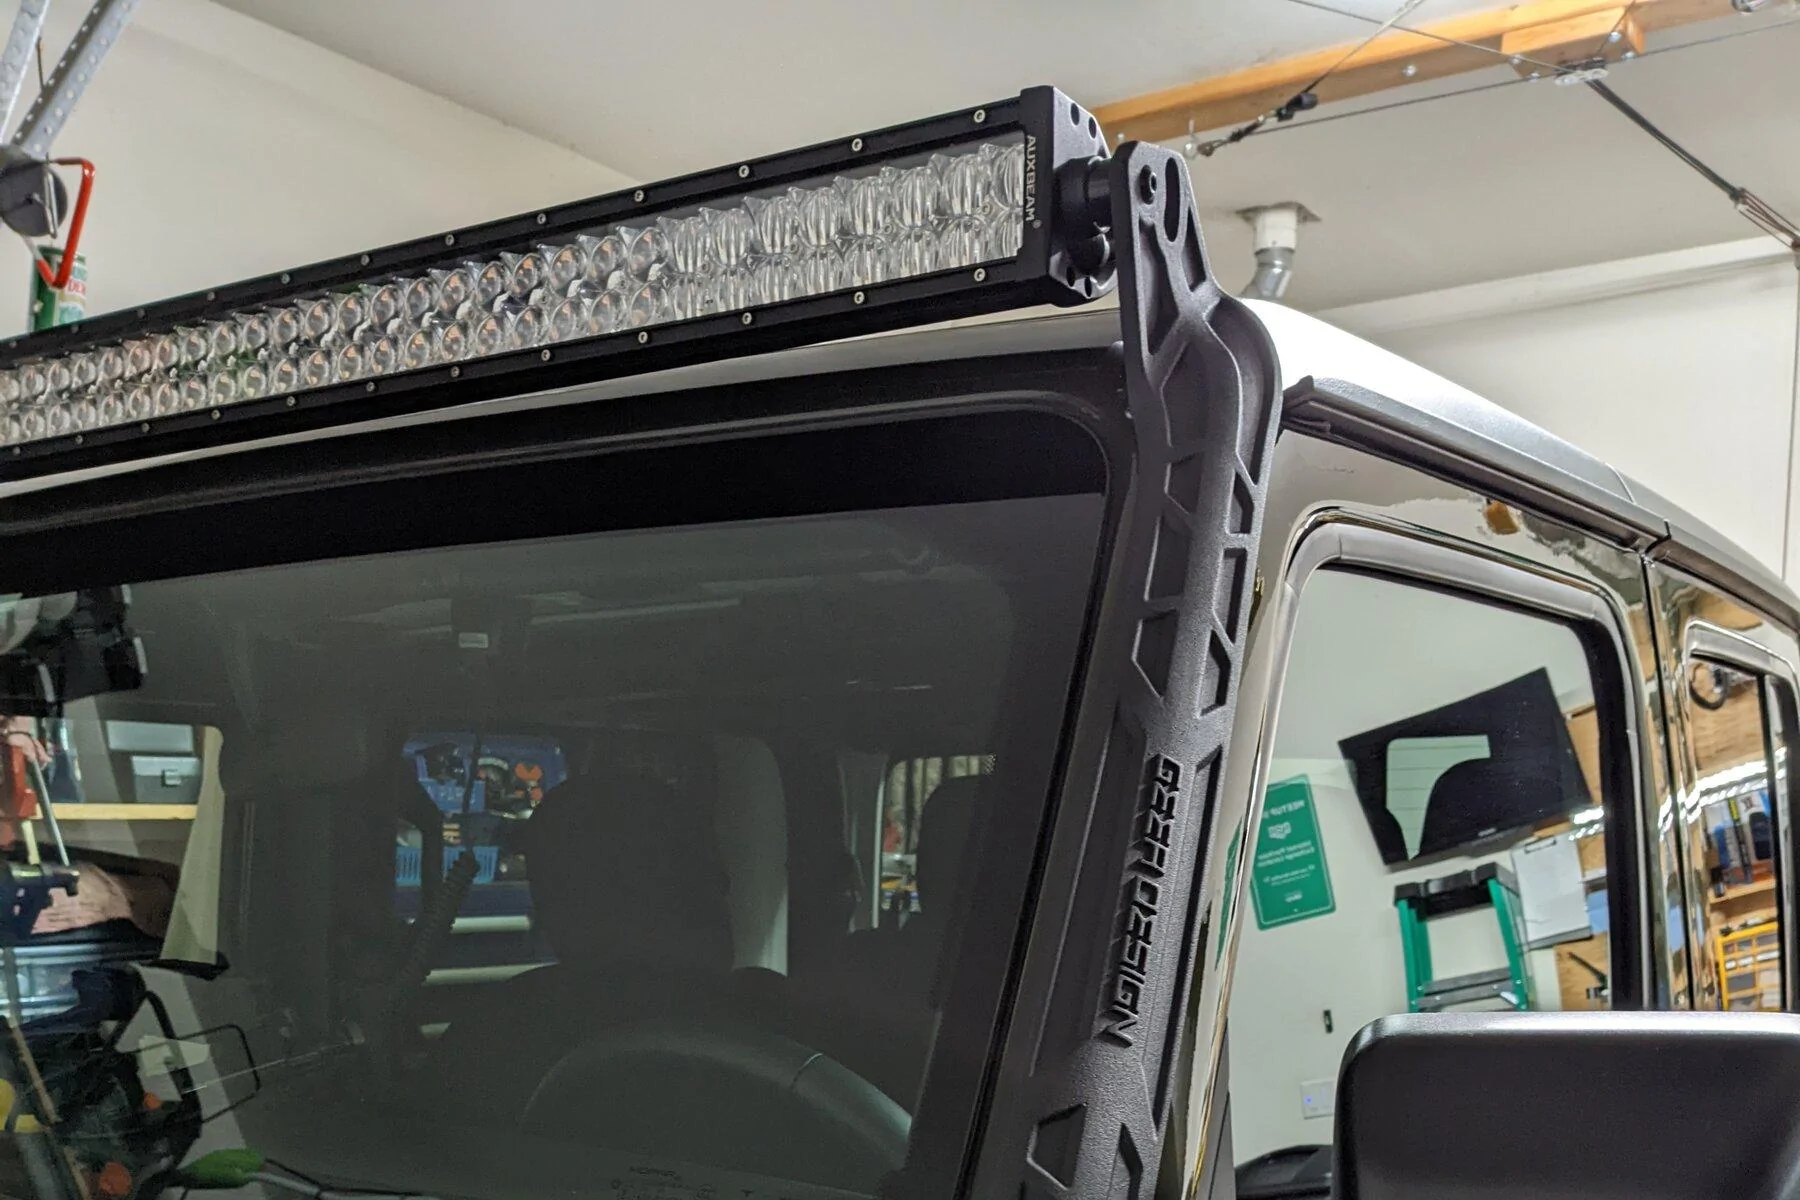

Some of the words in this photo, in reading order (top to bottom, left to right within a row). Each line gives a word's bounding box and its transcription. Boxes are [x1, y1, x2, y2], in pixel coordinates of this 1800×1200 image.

[1026, 135, 1037, 222] AUXBEAM
[1140, 753, 1183, 878] GEER
[1100, 874, 1163, 1049] DESIGN
